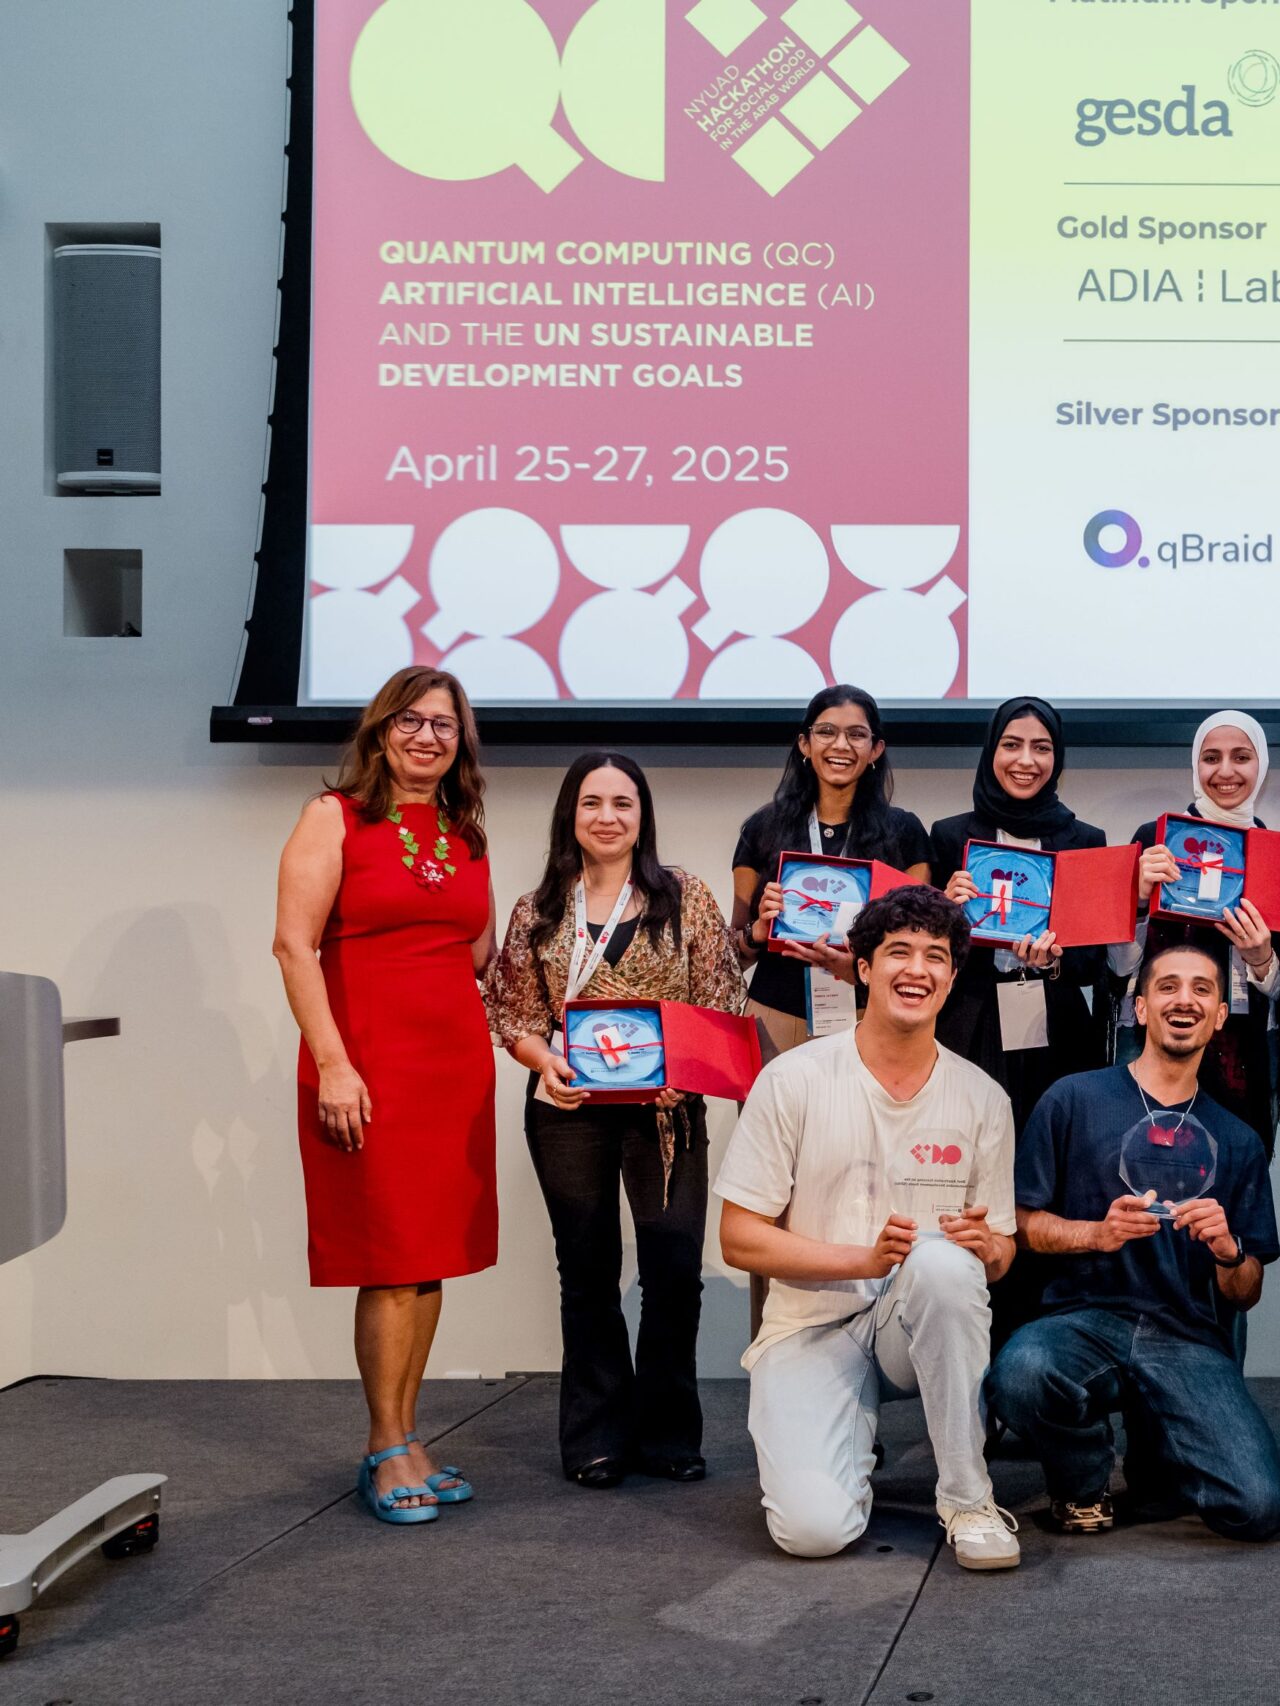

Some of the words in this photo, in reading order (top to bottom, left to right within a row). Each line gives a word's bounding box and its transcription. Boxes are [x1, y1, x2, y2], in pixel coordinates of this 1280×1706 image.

[684, 65, 740, 119] NYUAD
[696, 36, 797, 132] HACKATHON
[709, 117, 736, 142] FOR
[733, 81, 775, 119] SOCIAL
[773, 49, 806, 81] GOOD
[719, 138, 733, 151] IN
[731, 119, 753, 139] THE
[752, 93, 780, 120] ARAB
[778, 58, 816, 94] WORLD
[1075, 84, 1233, 147] gesda
[1057, 215, 1127, 239] Gold
[1138, 216, 1267, 244] Sponsor
[379, 240, 545, 264] QUANTUM
[556, 241, 751, 265] COMPUTING
[763, 242, 834, 269] (QC)
[379, 282, 562, 305] ARTIFICIAL
[573, 282, 806, 306] INTELLIGENCE
[818, 283, 874, 310] (AI)
[1078, 269, 1183, 302] ADIA
[379, 323, 450, 345] AND
[461, 323, 524, 346] THE
[535, 323, 579, 346] UN
[591, 323, 813, 347] SUSTAINABLE
[379, 363, 622, 387] DEVELOPMENT
[632, 364, 742, 387] GOALS
[1056, 400, 1143, 425] Silver
[1152, 403, 1280, 431] Sponsor
[386, 445, 497, 488] April
[515, 445, 653, 486] 25-27,
[672, 445, 789, 482] 2025
[1158, 534, 1272, 569] qBraid
